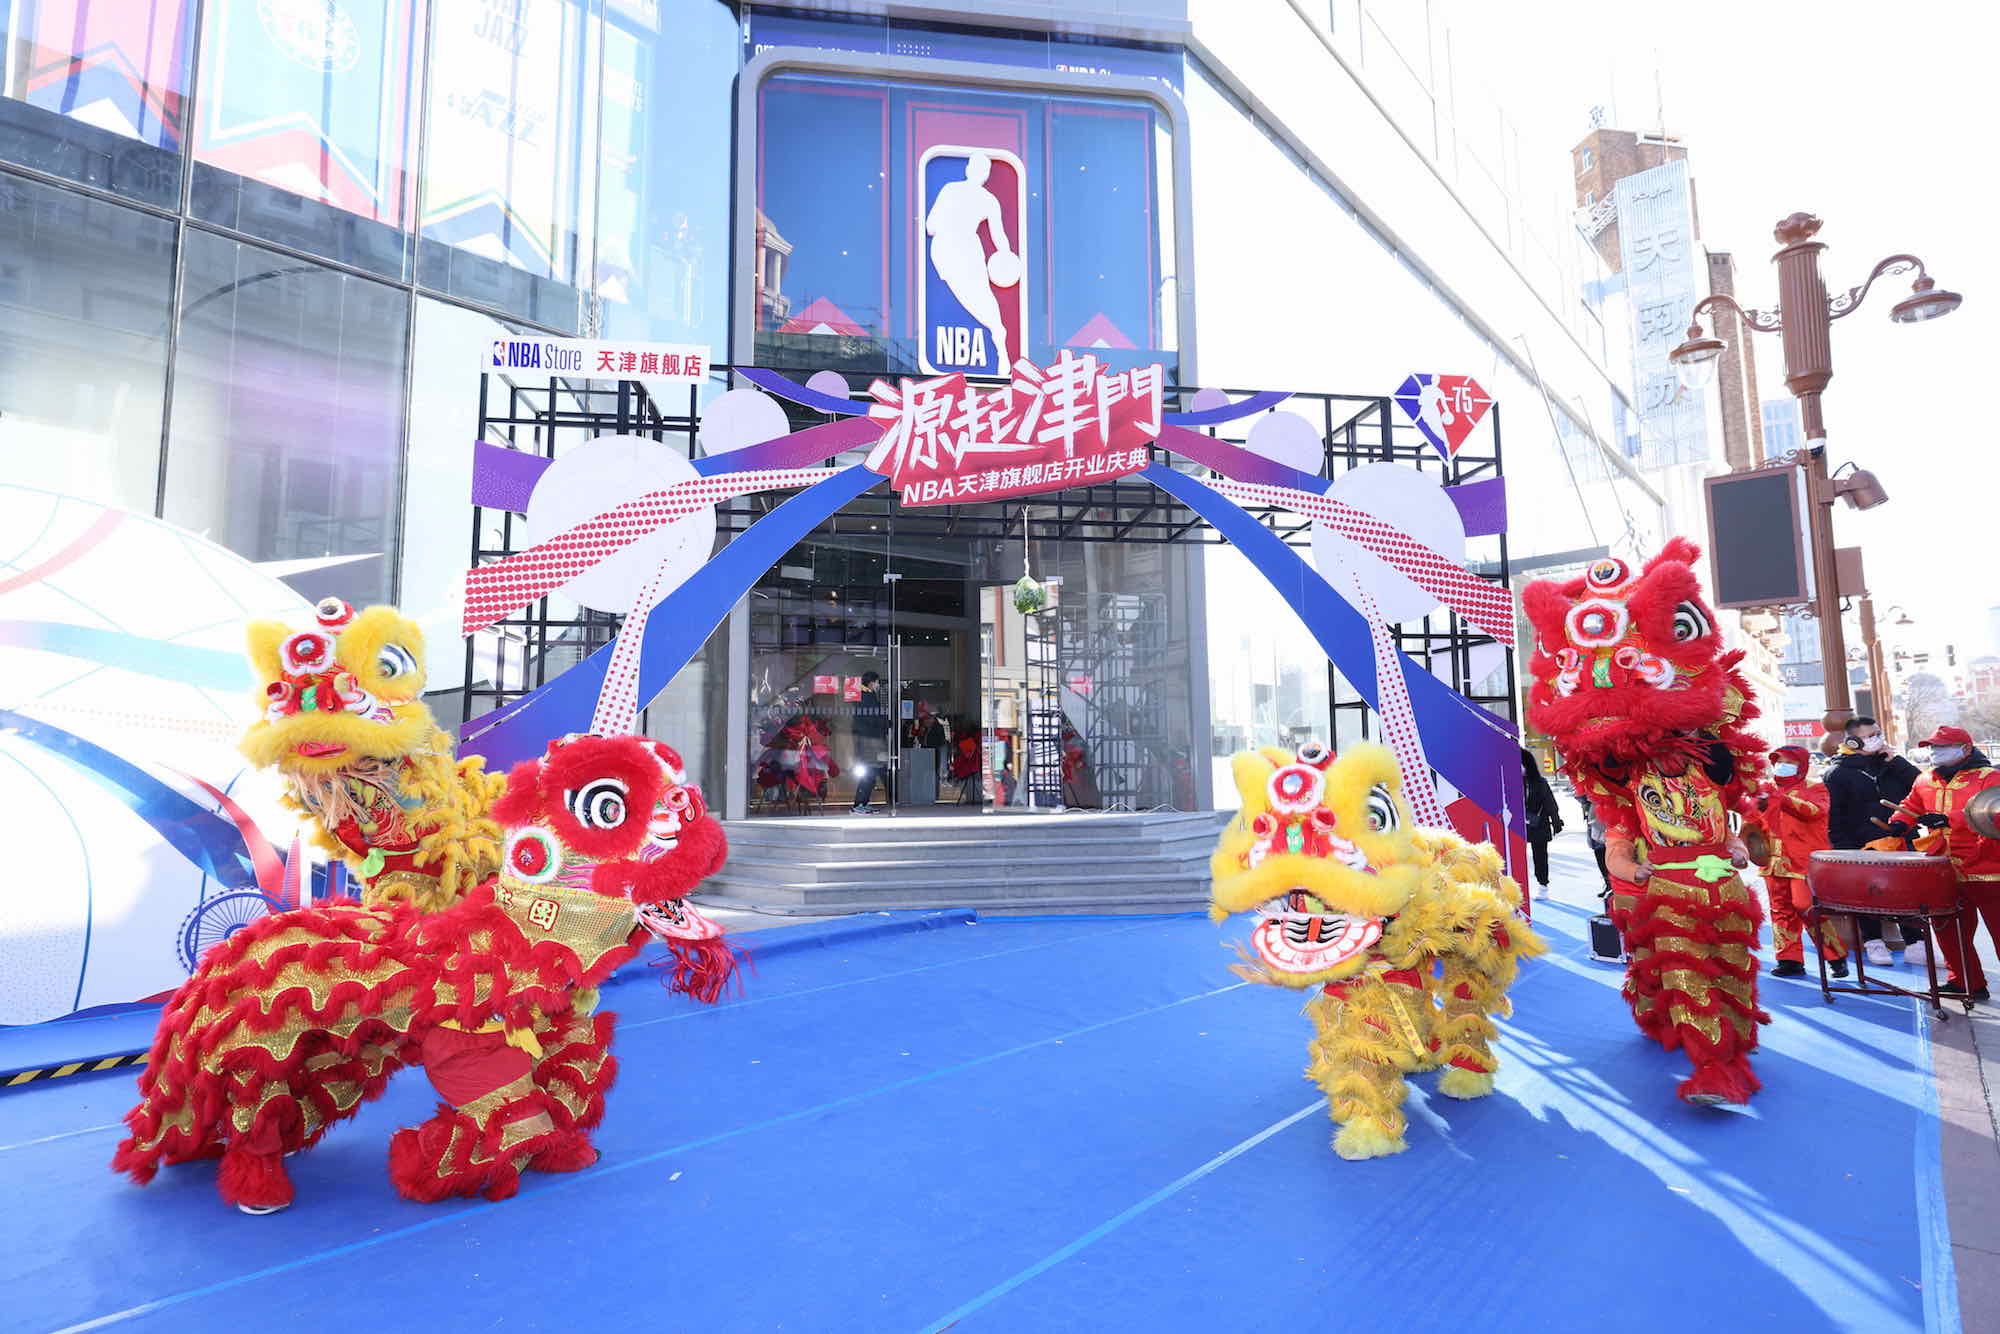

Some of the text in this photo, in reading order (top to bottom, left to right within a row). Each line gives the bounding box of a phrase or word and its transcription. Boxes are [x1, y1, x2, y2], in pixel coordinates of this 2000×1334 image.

[508, 342, 702, 377] NBA Store 天津旗舰店
[936, 326, 988, 367] NBA
[864, 349, 1163, 483] 源起津門
[1451, 386, 1473, 413] 75
